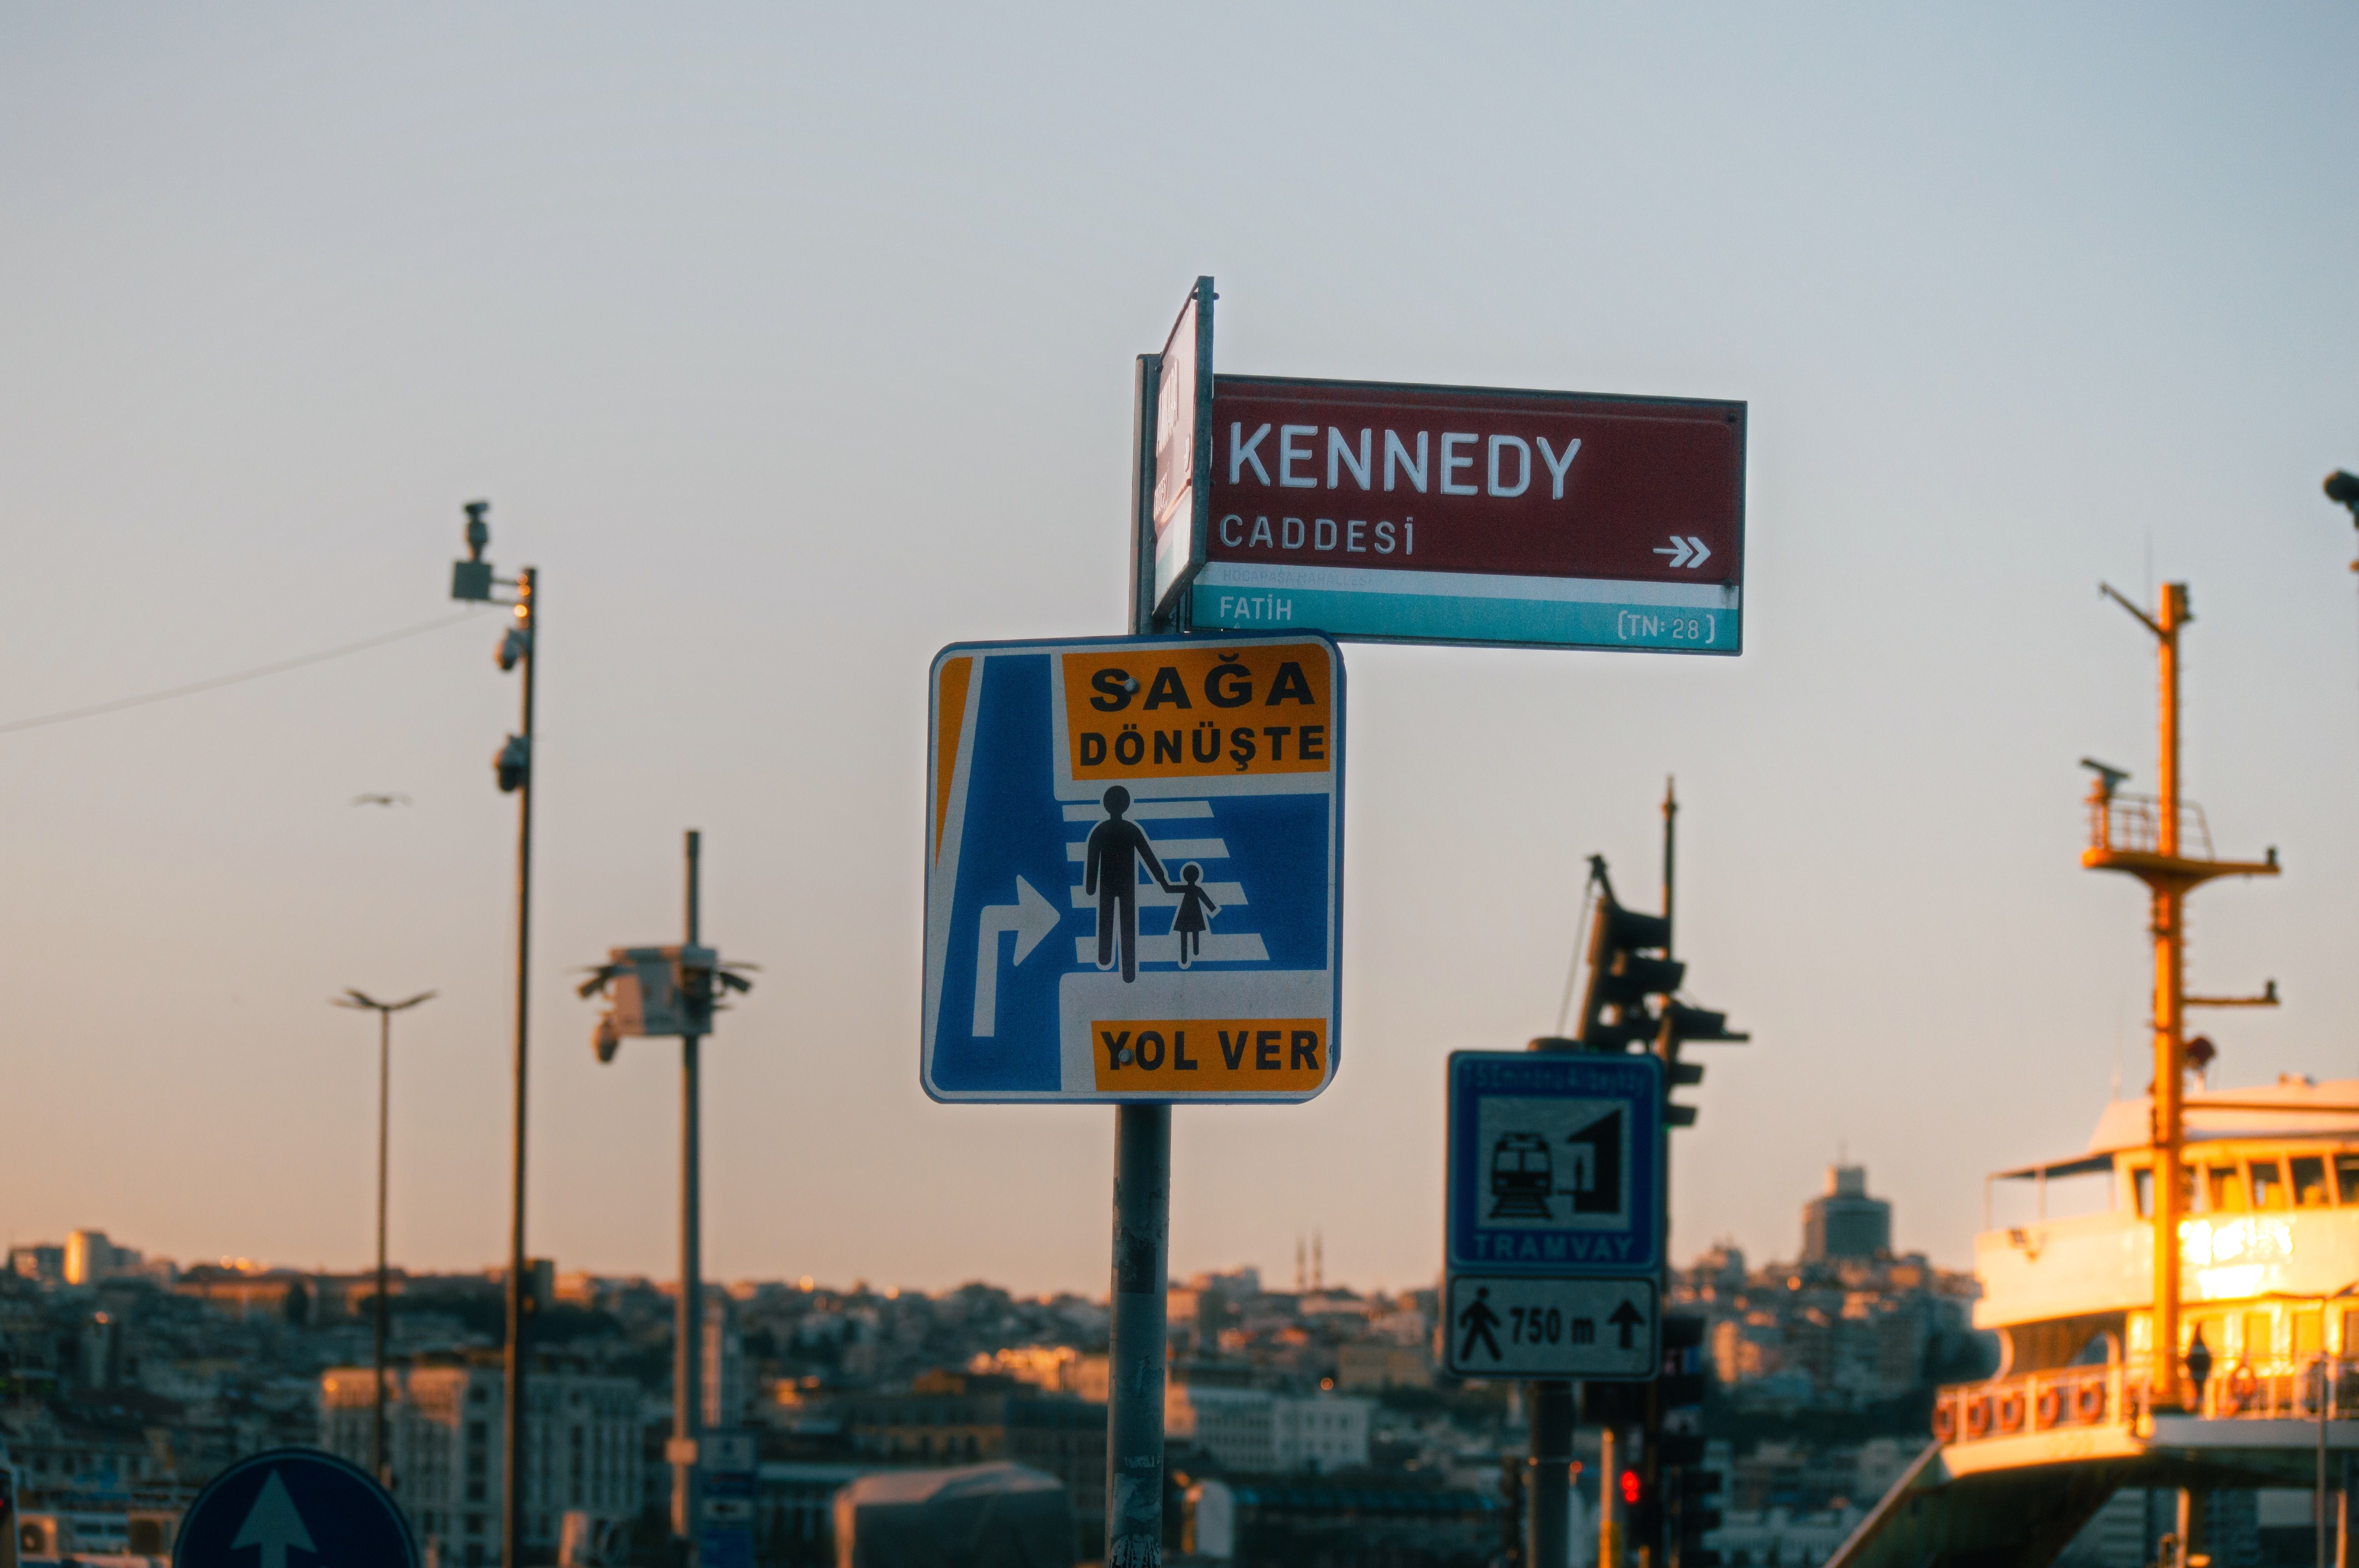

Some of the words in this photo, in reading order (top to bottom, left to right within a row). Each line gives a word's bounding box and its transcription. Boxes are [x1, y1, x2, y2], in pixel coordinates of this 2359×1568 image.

[1229, 421, 1581, 500] KENNEDY
[1219, 514, 1414, 555] CADDESİ
[1219, 594, 1292, 621] FATİH
[1089, 653, 1316, 713] SAĞA
[1080, 721, 1325, 771] DÖNÜŞTE
[1100, 1030, 1198, 1071] YOL
[1218, 1030, 1320, 1071] VER
[1473, 1234, 1633, 1260] TRAMVAY
[1509, 1308, 1561, 1345] 750
[1572, 1316, 1595, 1345] m
